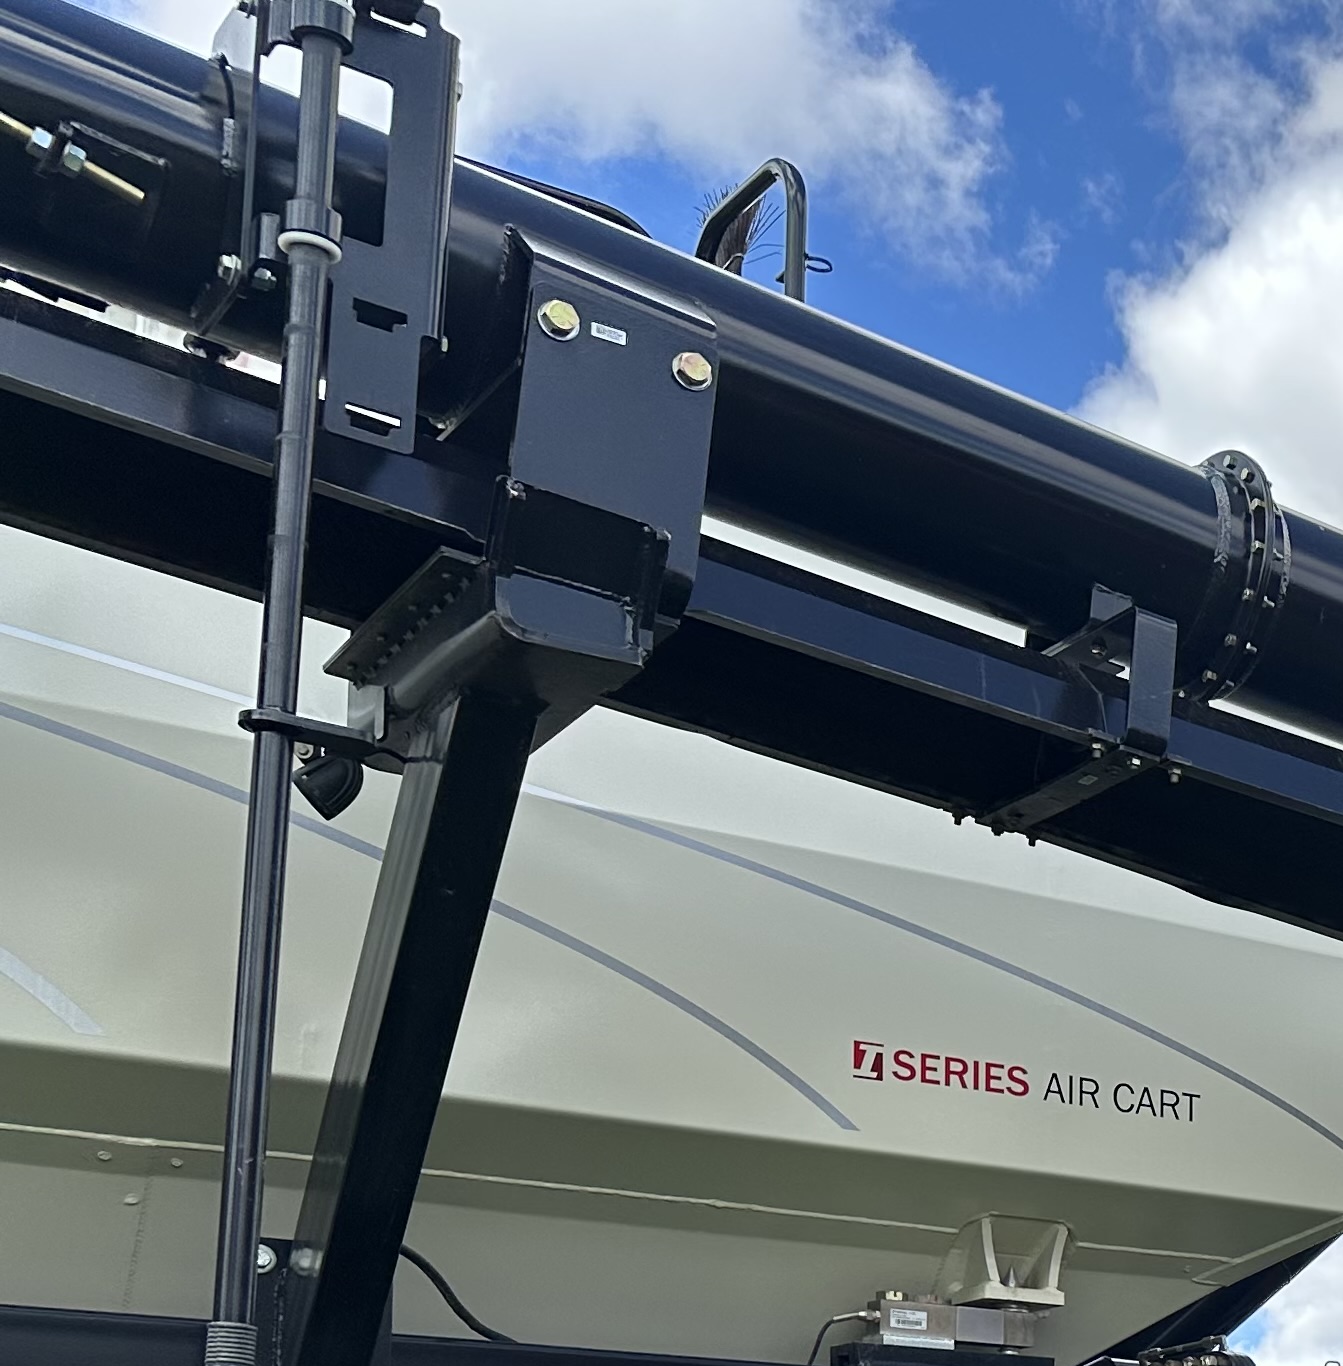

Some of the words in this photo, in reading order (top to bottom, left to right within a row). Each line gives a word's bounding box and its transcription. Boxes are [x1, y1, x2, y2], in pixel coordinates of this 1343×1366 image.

[891, 1049, 1030, 1097] SERIES
[1043, 1072, 1101, 1109] AIR
[1112, 1082, 1201, 1122] CART
